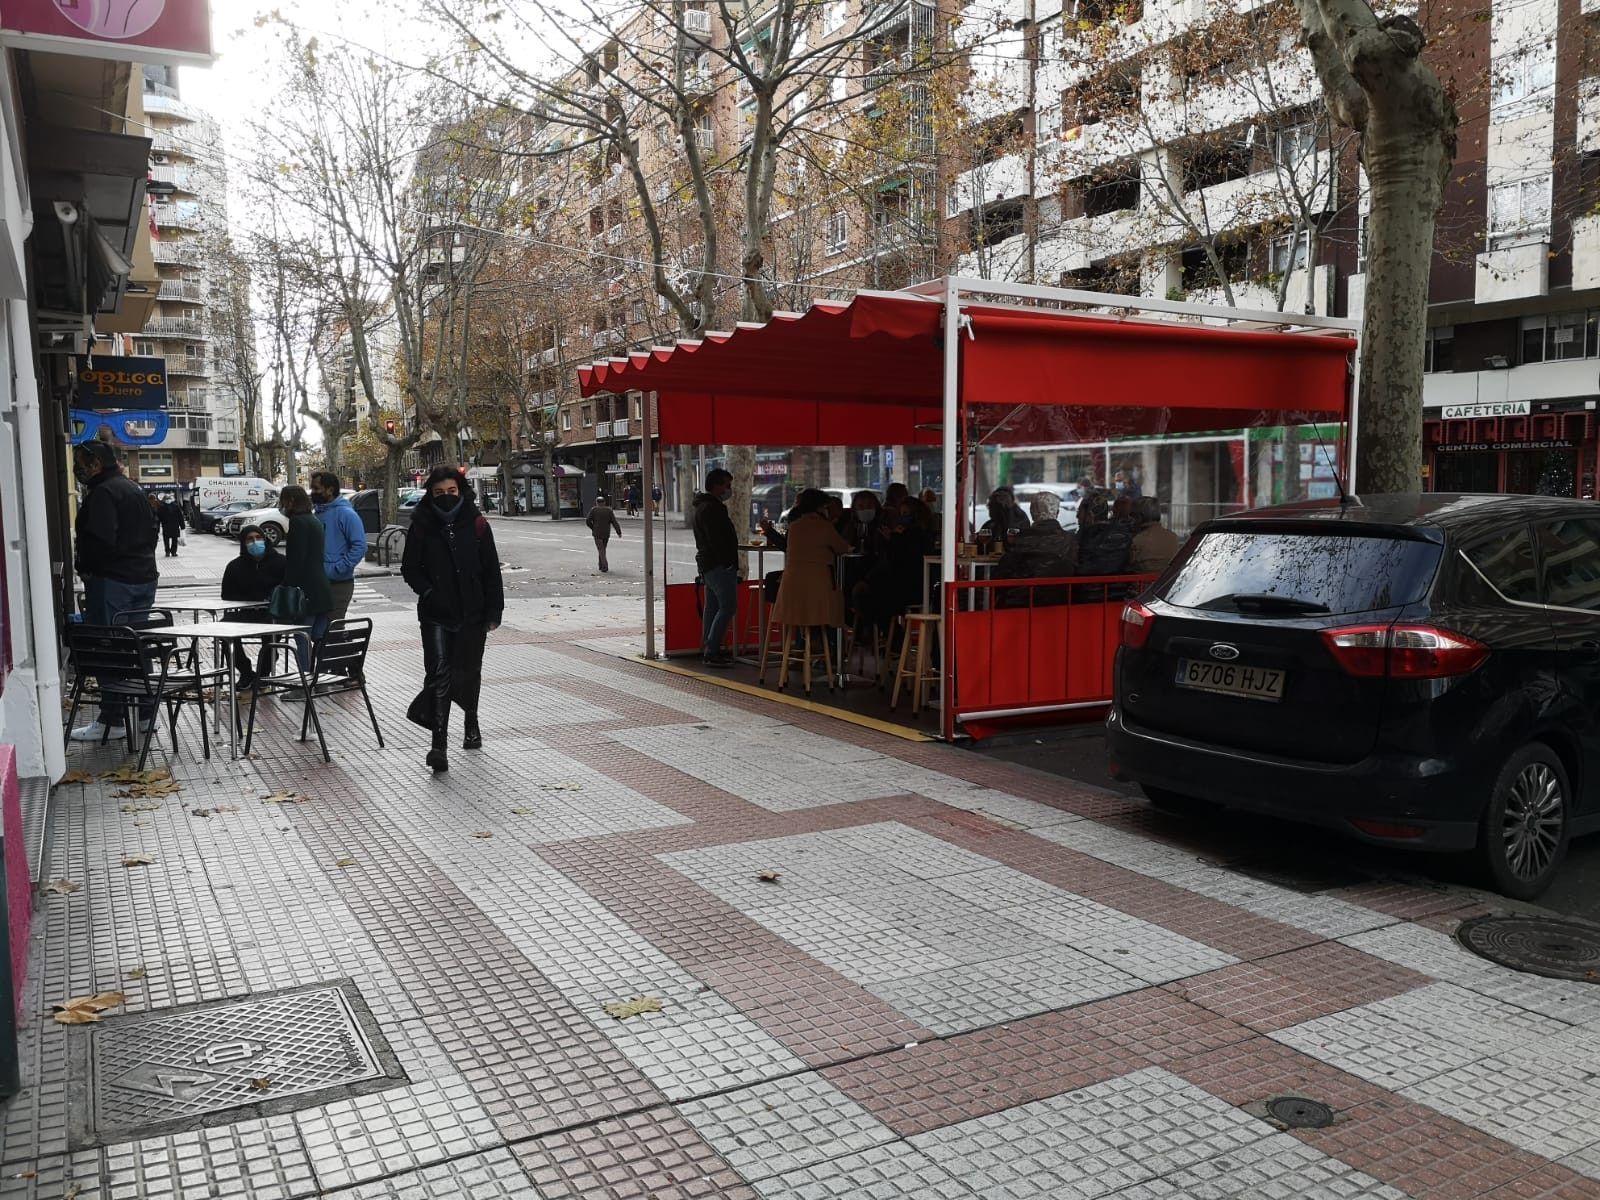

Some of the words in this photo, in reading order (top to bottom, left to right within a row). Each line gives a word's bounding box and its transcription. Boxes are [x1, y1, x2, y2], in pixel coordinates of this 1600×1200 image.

[94, 384, 143, 396] Duero
[1445, 403, 1526, 417] CAFETERIA
[1437, 444, 1488, 452] CENTRO
[1492, 440, 1573, 450] COMERCIAL
[1189, 662, 1235, 686] 6706
[1241, 668, 1280, 693] HJZ
